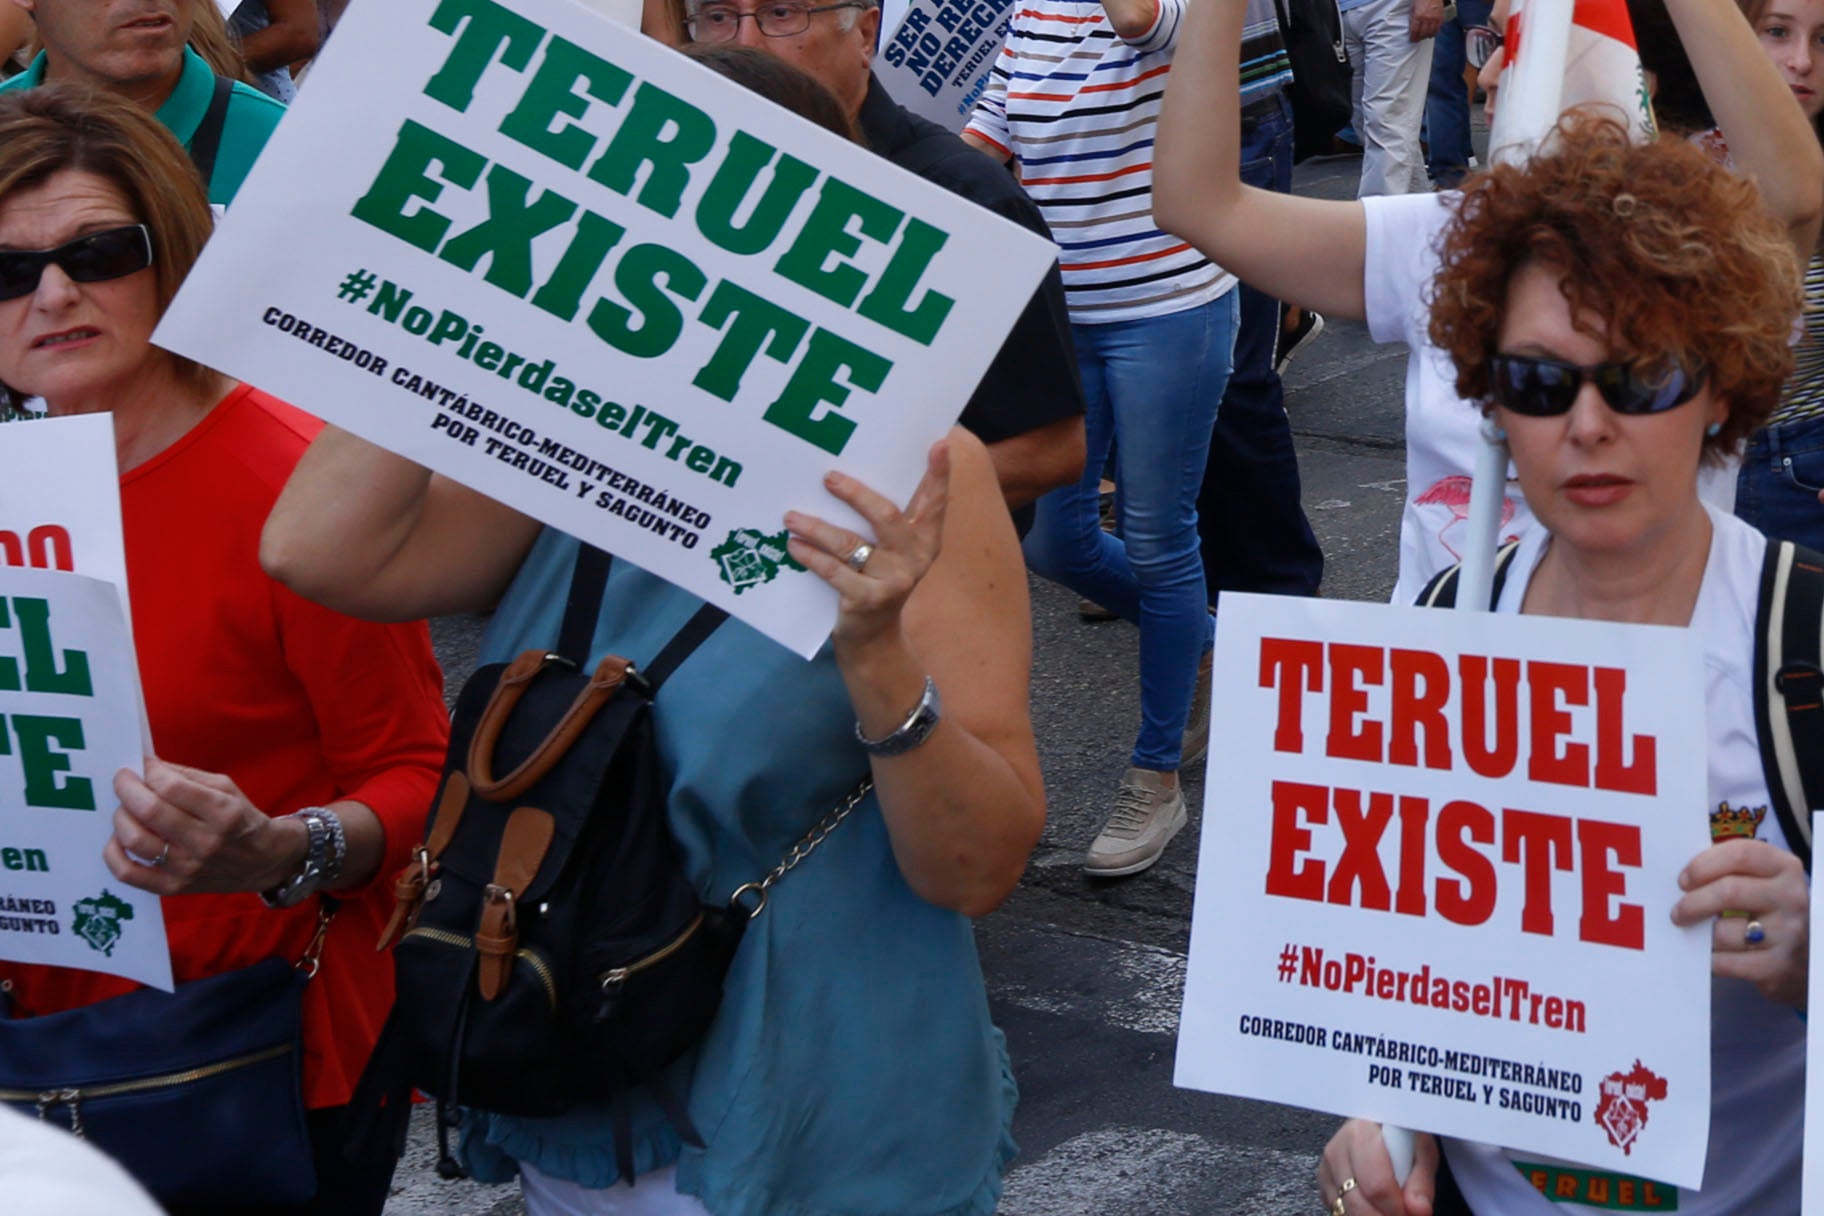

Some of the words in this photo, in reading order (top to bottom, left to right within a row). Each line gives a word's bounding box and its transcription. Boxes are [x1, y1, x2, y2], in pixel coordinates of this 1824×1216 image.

[885, 7, 930, 68] SER
[906, 38, 941, 77] NO
[952, 38, 996, 89] TERUEL
[351, 119, 895, 458] EXISTE
[263, 306, 388, 377] CORREDOR
[391, 366, 711, 531] CANTÁBRICO-MEDITERRÁNEO
[337, 268, 743, 488] #NoPierdaselTren
[431, 413, 478, 447] POR
[485, 438, 569, 491] TERUEL
[577, 480, 593, 499] Y
[595, 491, 699, 549] SAGUNTO
[1258, 637, 1658, 796] TERUEL
[1265, 780, 1645, 952] EXISTE
[1277, 943, 1586, 1033] #NoPierdaselTren
[1239, 1015, 1326, 1048] CORREDOR
[1332, 1030, 1583, 1095] CANTÁBRICO-MEDITERRÁNEO
[1368, 1064, 1402, 1088] POR
[1408, 1070, 1476, 1103] TERUEL
[1482, 1085, 1494, 1105] Y
[1499, 1088, 1582, 1123] SAGUNTO
